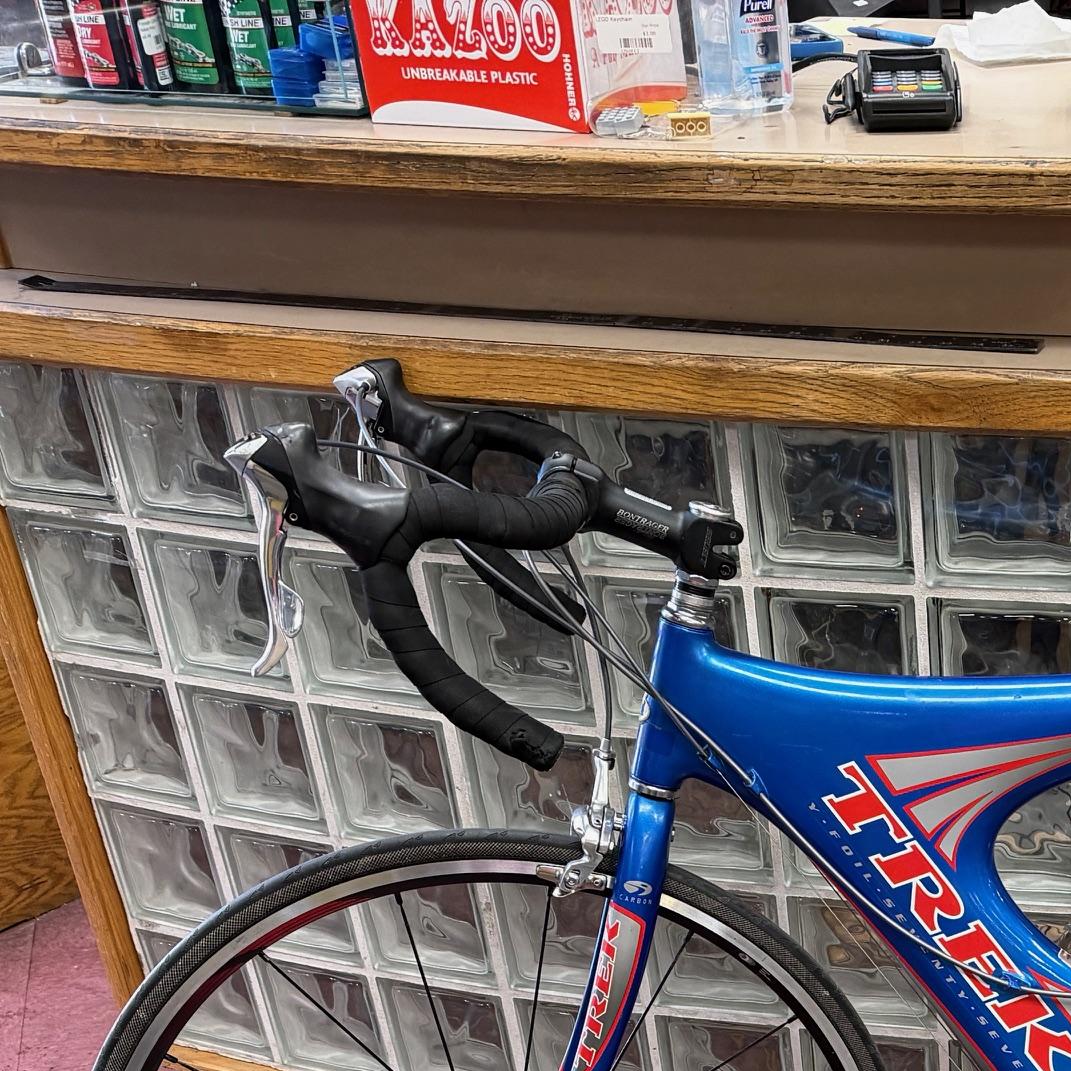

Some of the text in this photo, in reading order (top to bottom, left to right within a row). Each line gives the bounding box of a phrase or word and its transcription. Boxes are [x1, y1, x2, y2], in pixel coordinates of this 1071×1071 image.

[743, 0, 772, 12] Purell
[241, 18, 260, 28] LINE
[371, 0, 562, 63] KAZOO
[401, 67, 539, 86] UNBREAKABLE PLASTIC
[562, 53, 577, 107] HOHNER
[617, 508, 669, 534] BONTRAGER
[619, 894, 653, 906] CARBON
[574, 918, 622, 1068] TREK
